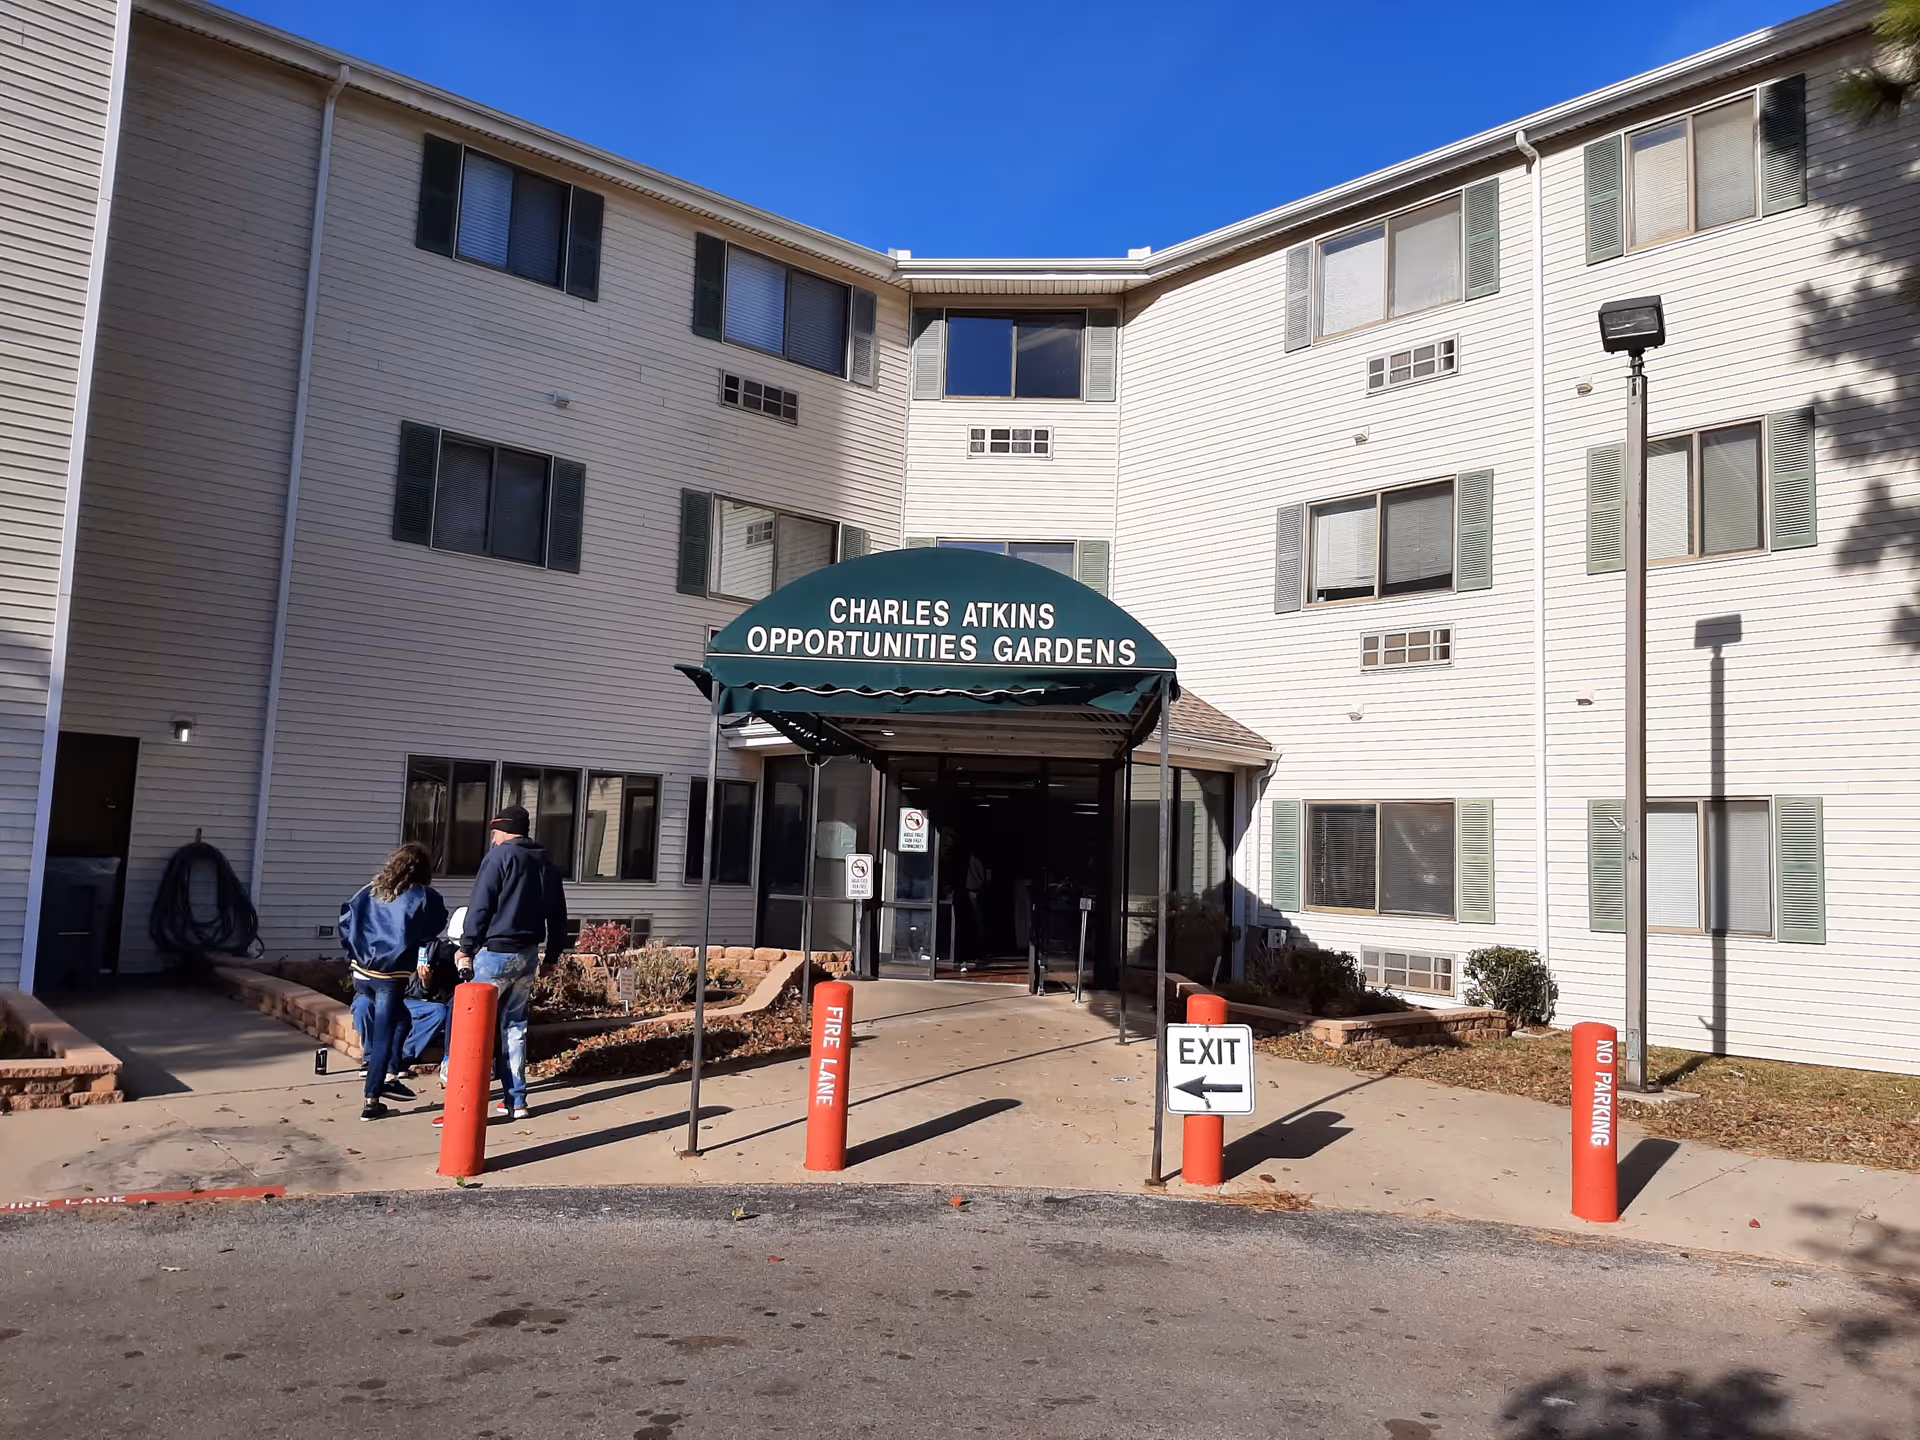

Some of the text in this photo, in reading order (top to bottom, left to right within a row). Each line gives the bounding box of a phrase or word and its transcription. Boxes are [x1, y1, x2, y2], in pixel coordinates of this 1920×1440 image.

[829, 596, 1055, 631] CHARLES ATKINS
[746, 625, 1137, 666] OPPORTUNITIES GARDENS
[815, 1005, 845, 1109] FIRE LANE
[1178, 1037, 1241, 1065] EXIT
[1590, 1039, 1614, 1147] NO PARKING
[65, 1195, 127, 1205] LANE
